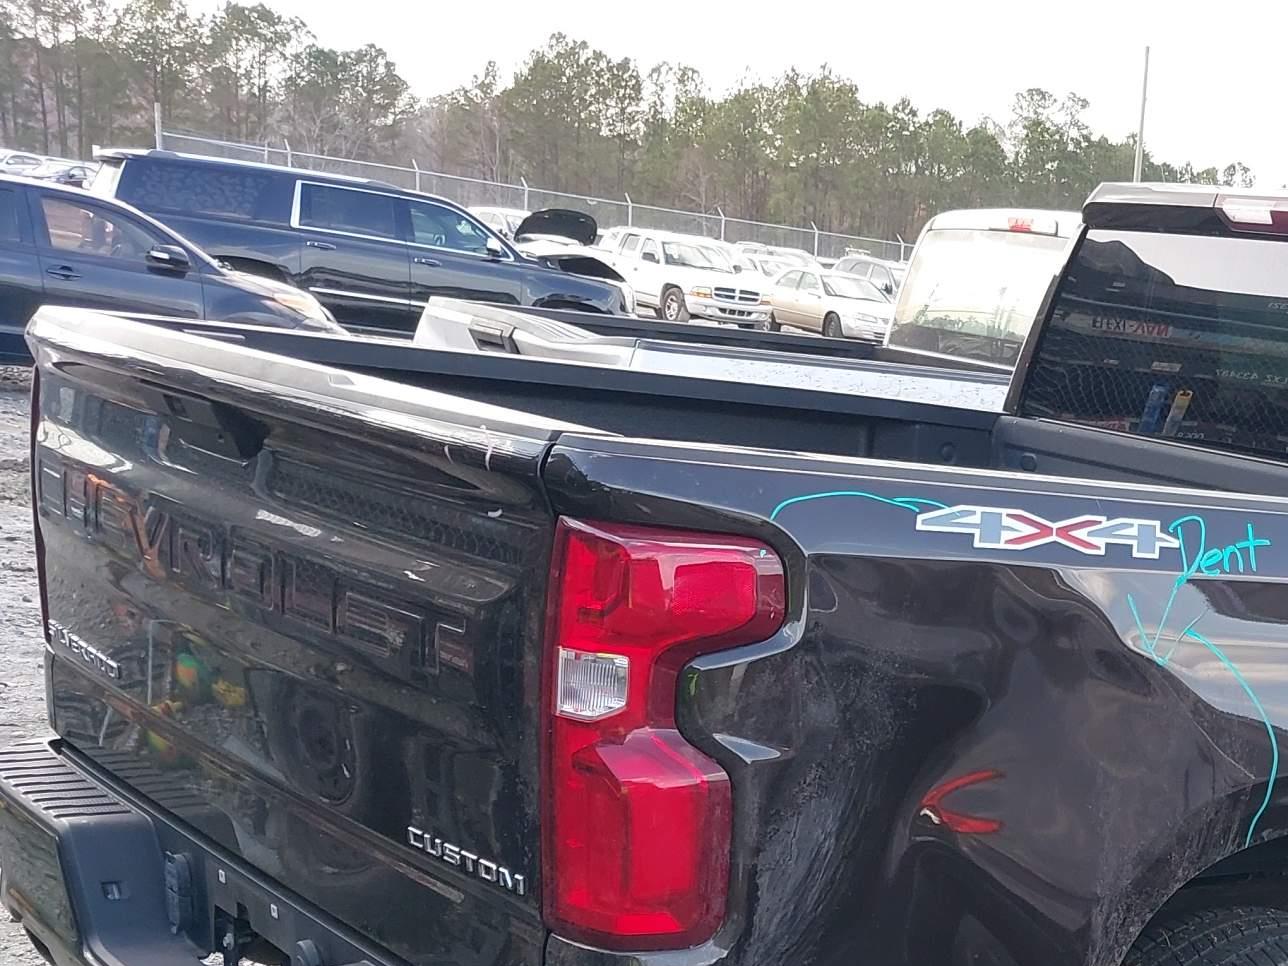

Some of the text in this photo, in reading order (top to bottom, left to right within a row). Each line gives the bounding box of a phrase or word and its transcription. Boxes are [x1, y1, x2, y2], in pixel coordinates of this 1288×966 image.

[915, 503, 1181, 560] 4X4
[1168, 514, 1272, 579] Dent
[407, 826, 525, 895] CUSTOM
